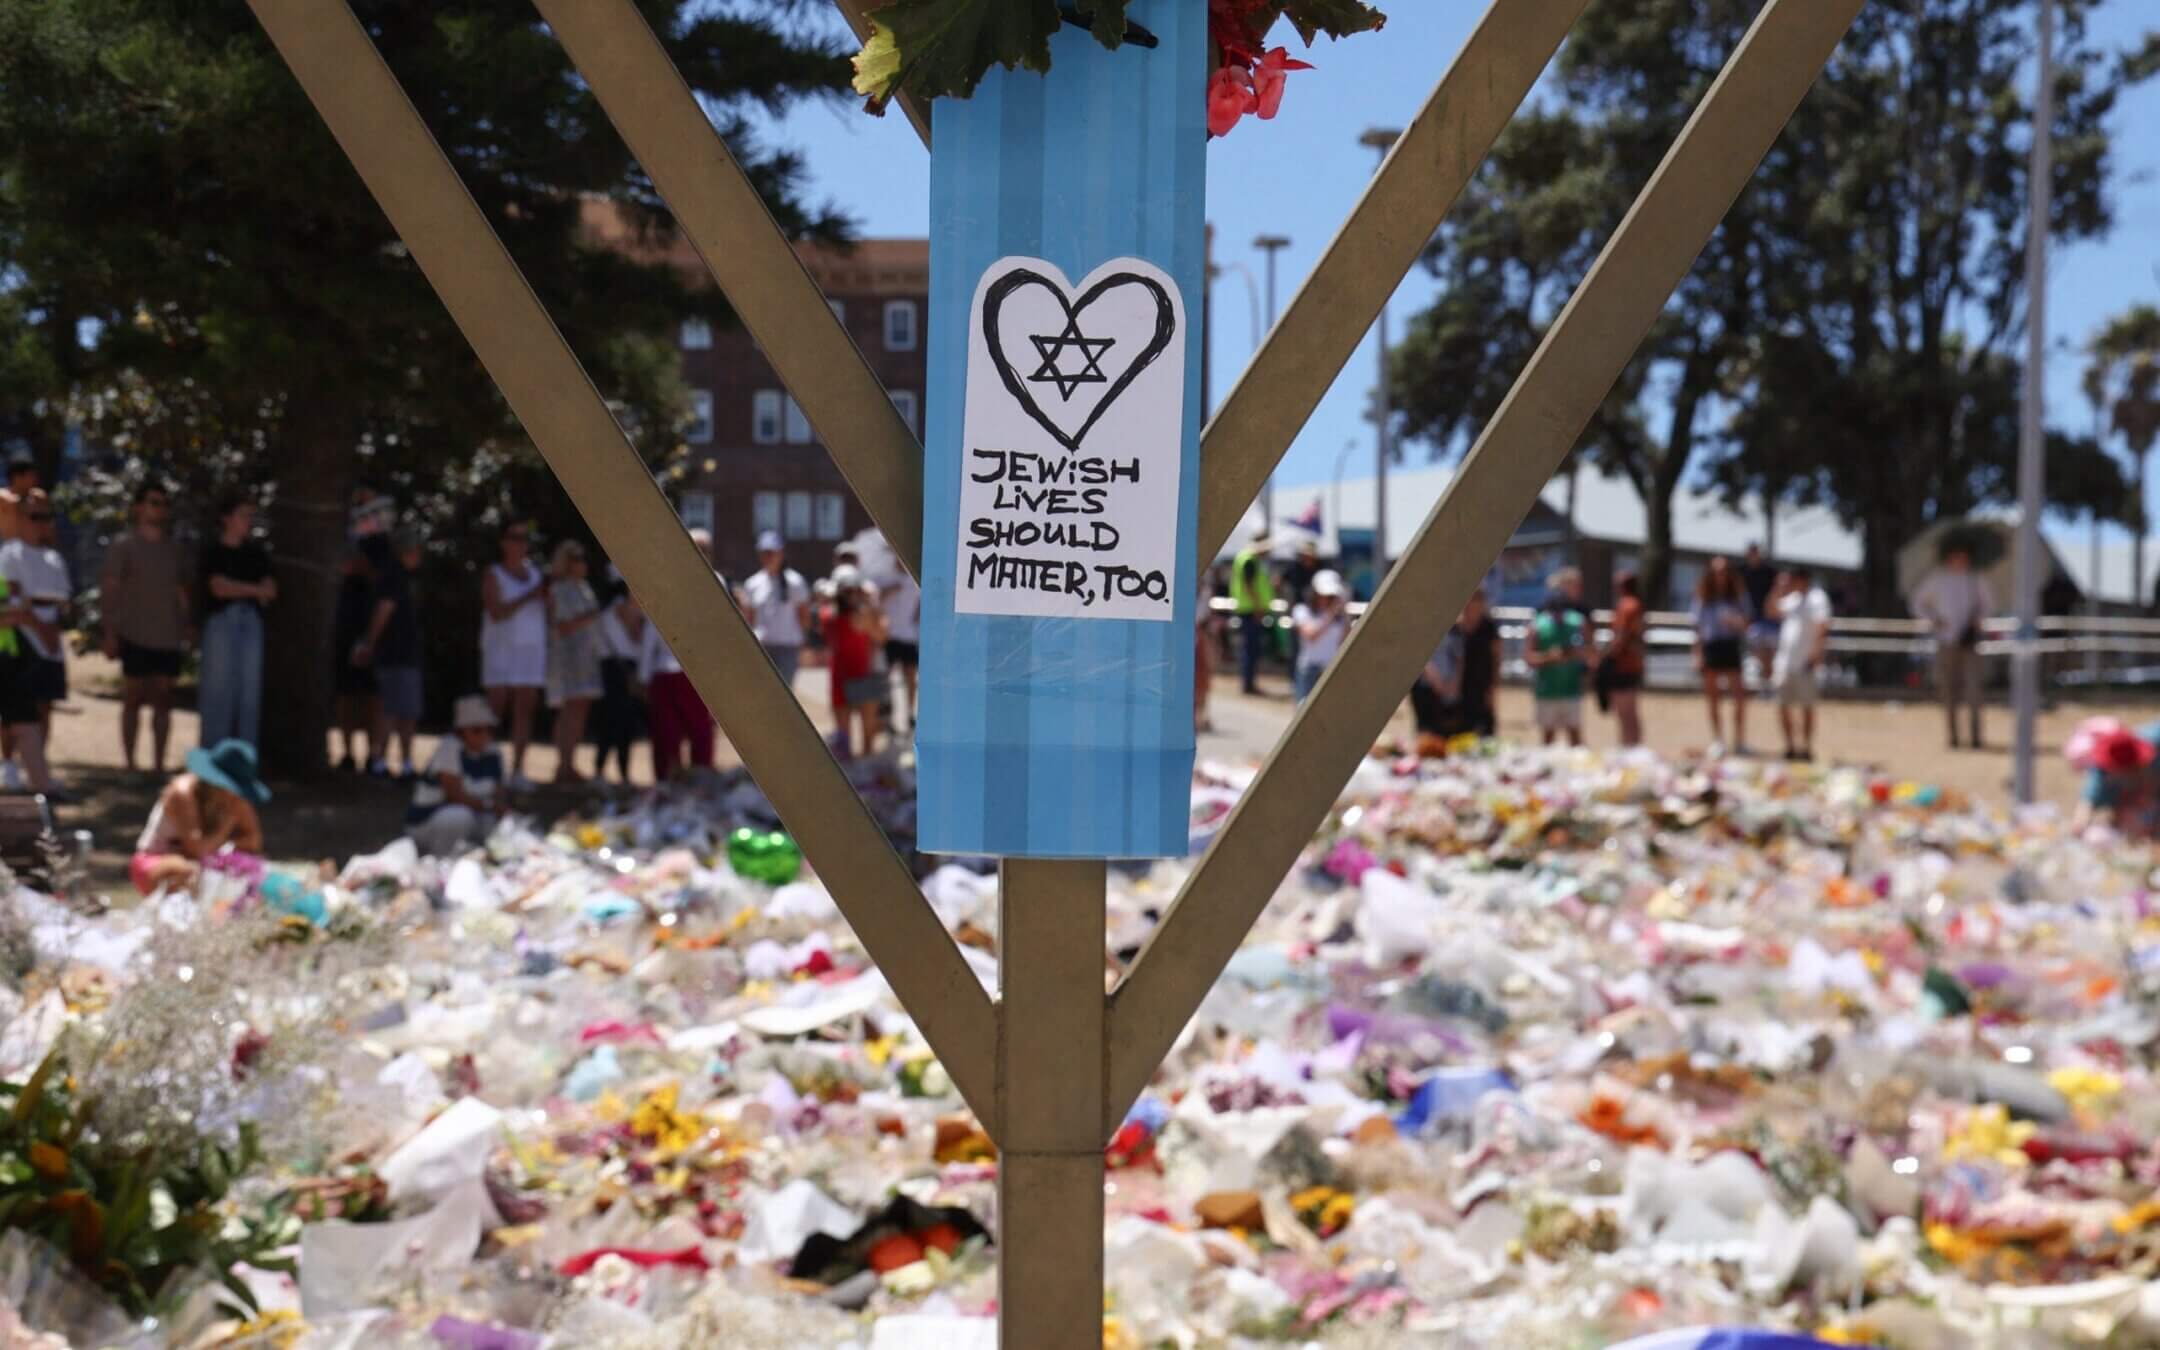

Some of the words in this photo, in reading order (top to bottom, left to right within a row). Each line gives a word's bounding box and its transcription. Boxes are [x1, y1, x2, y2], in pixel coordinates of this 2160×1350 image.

[966, 518, 1120, 552] SHOULD
[967, 552, 1095, 606] MATTER,
[1094, 565, 1170, 604] TOO.
